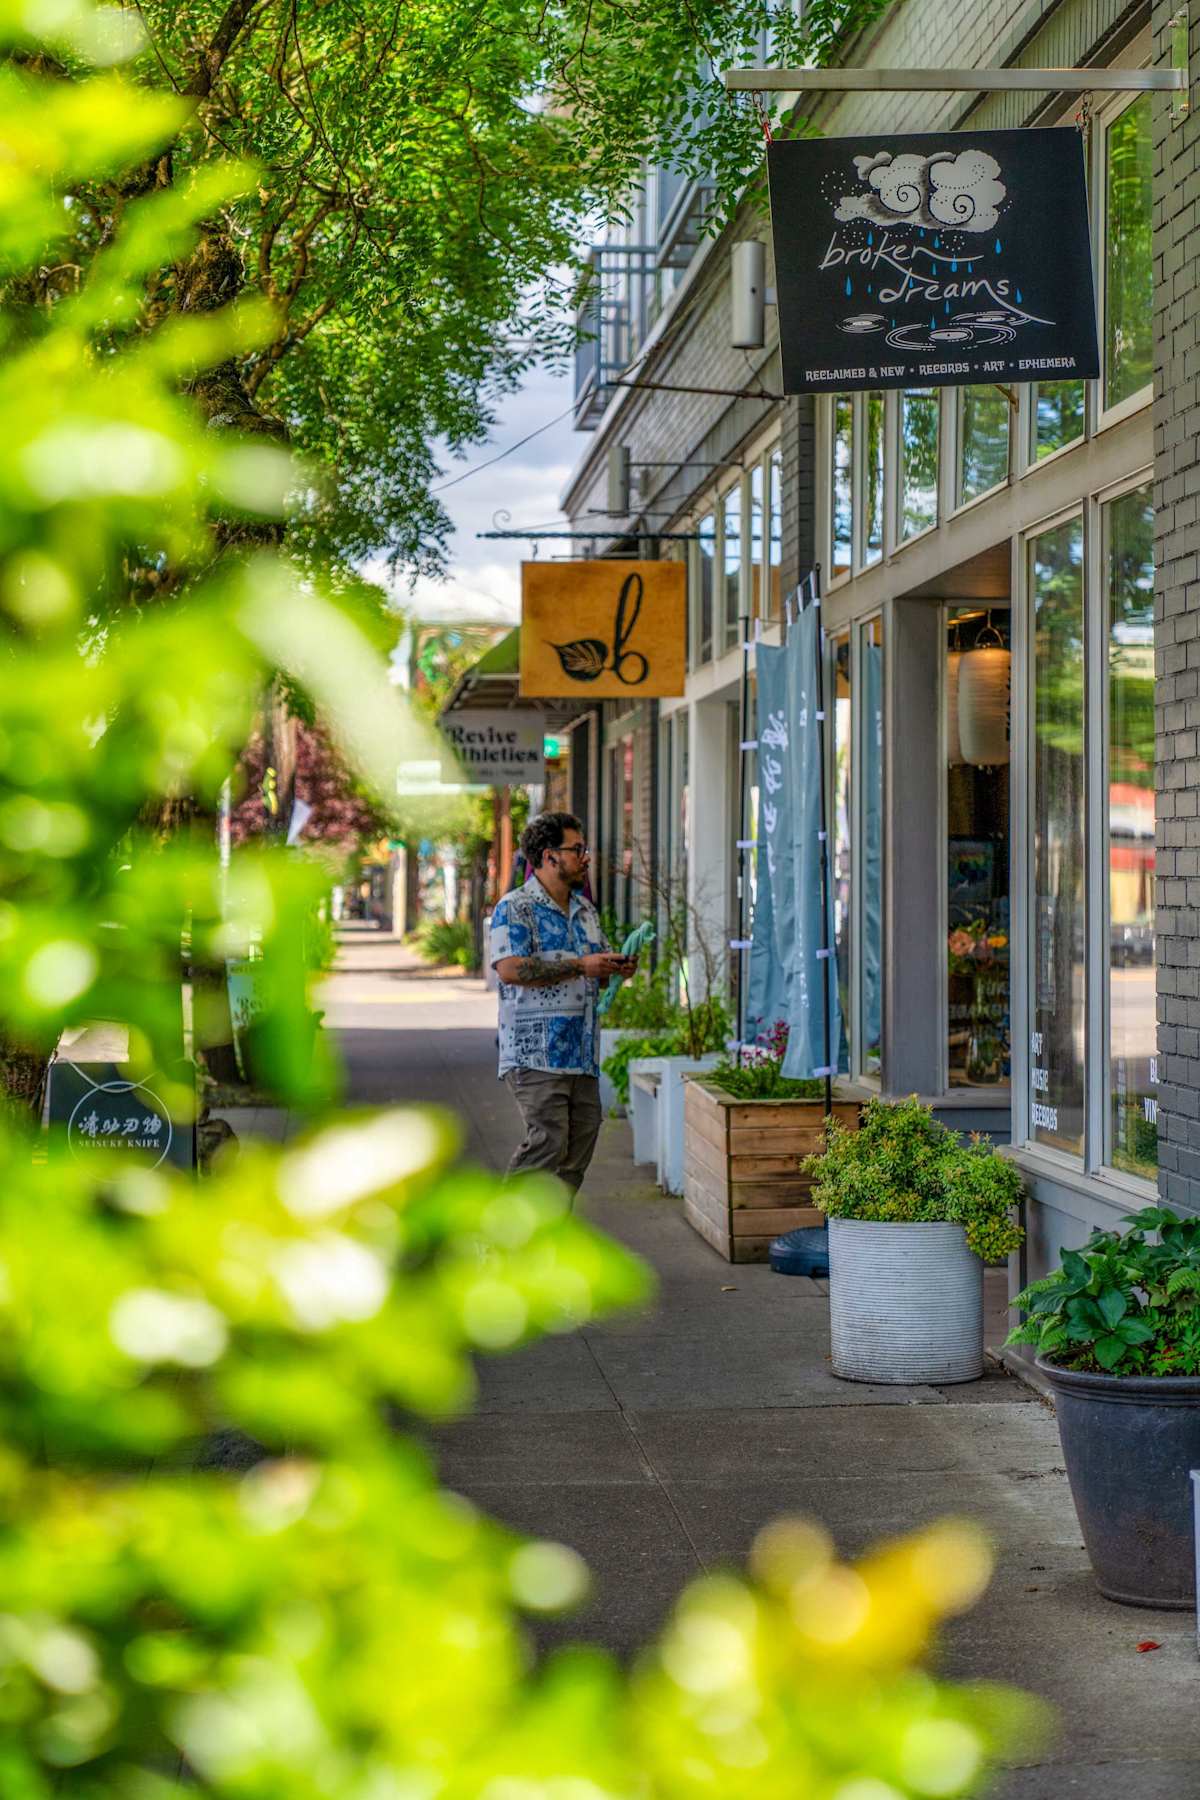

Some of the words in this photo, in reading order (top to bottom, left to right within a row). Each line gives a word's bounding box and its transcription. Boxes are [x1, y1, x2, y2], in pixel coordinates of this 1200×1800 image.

[818, 231, 984, 283] broken
[879, 268, 1056, 325] dreams
[805, 368, 866, 382] RECLAIMED
[869, 367, 878, 378] &
[880, 366, 905, 377] NEW
[919, 362, 970, 375] RECORDS
[983, 360, 1005, 372] ART
[1019, 357, 1076, 370] EPHEMERA
[127, 1139, 160, 1148] KNIFE
